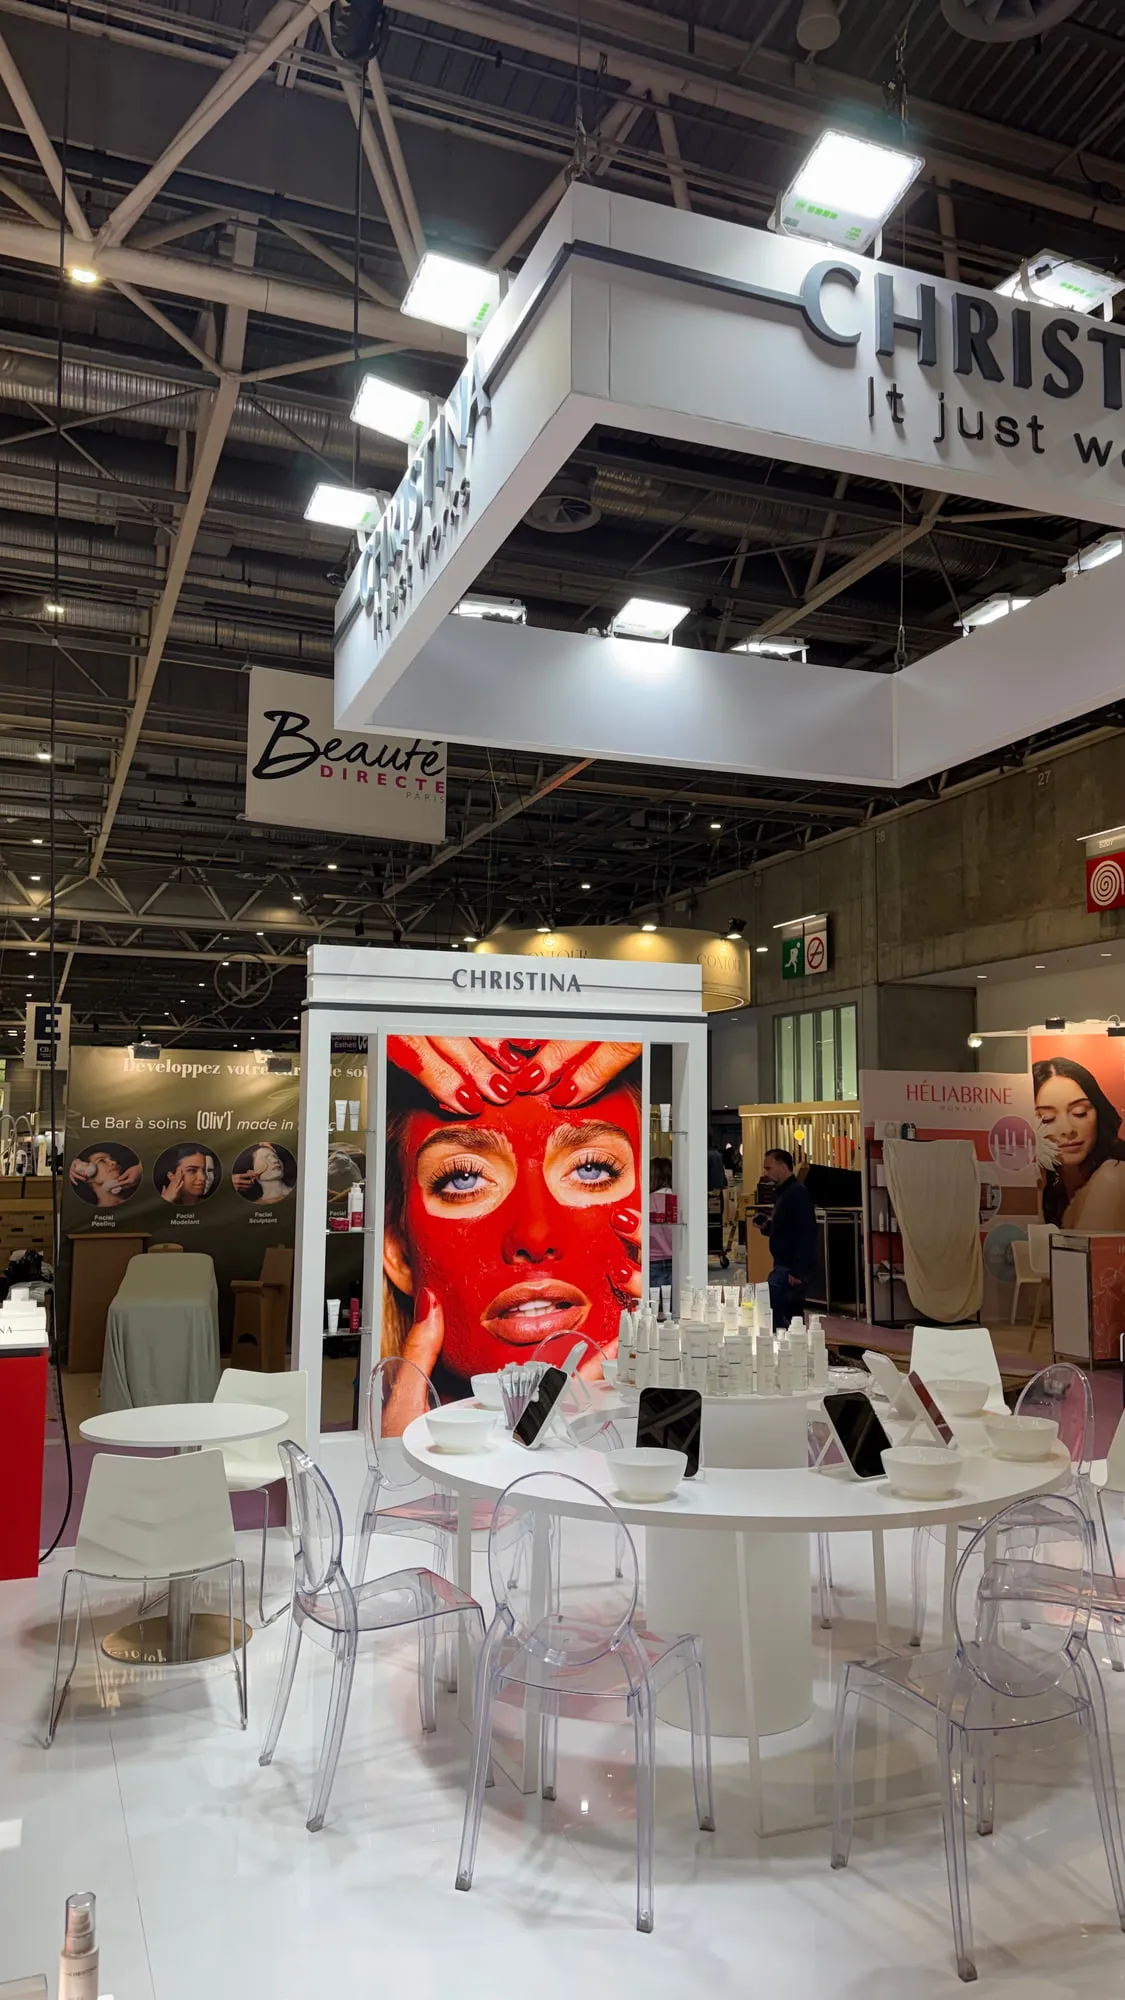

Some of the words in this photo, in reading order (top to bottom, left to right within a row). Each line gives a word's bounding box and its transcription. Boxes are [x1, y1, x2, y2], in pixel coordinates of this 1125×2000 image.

[800, 260, 1125, 410] CHRIST
[868, 376, 904, 424] It
[933, 392, 1045, 454] just
[1073, 433, 1125, 468] w
[252, 710, 445, 779] Beauté
[320, 765, 445, 794] DIRECTE
[1038, 770, 1051, 786] 27
[406, 791, 445, 804] PARIS
[452, 968, 582, 992] CHRISTINA
[34, 1006, 62, 1041] E
[123, 1058, 221, 1078] Développez
[906, 1079, 1014, 1105] HÉLIABRINE
[82, 1116, 100, 1129] Le
[105, 1116, 131, 1129] Bar
[135, 1116, 144, 1129] à
[148, 1118, 187, 1129] soins
[236, 1119, 278, 1130] made
[281, 1119, 294, 1130] in
